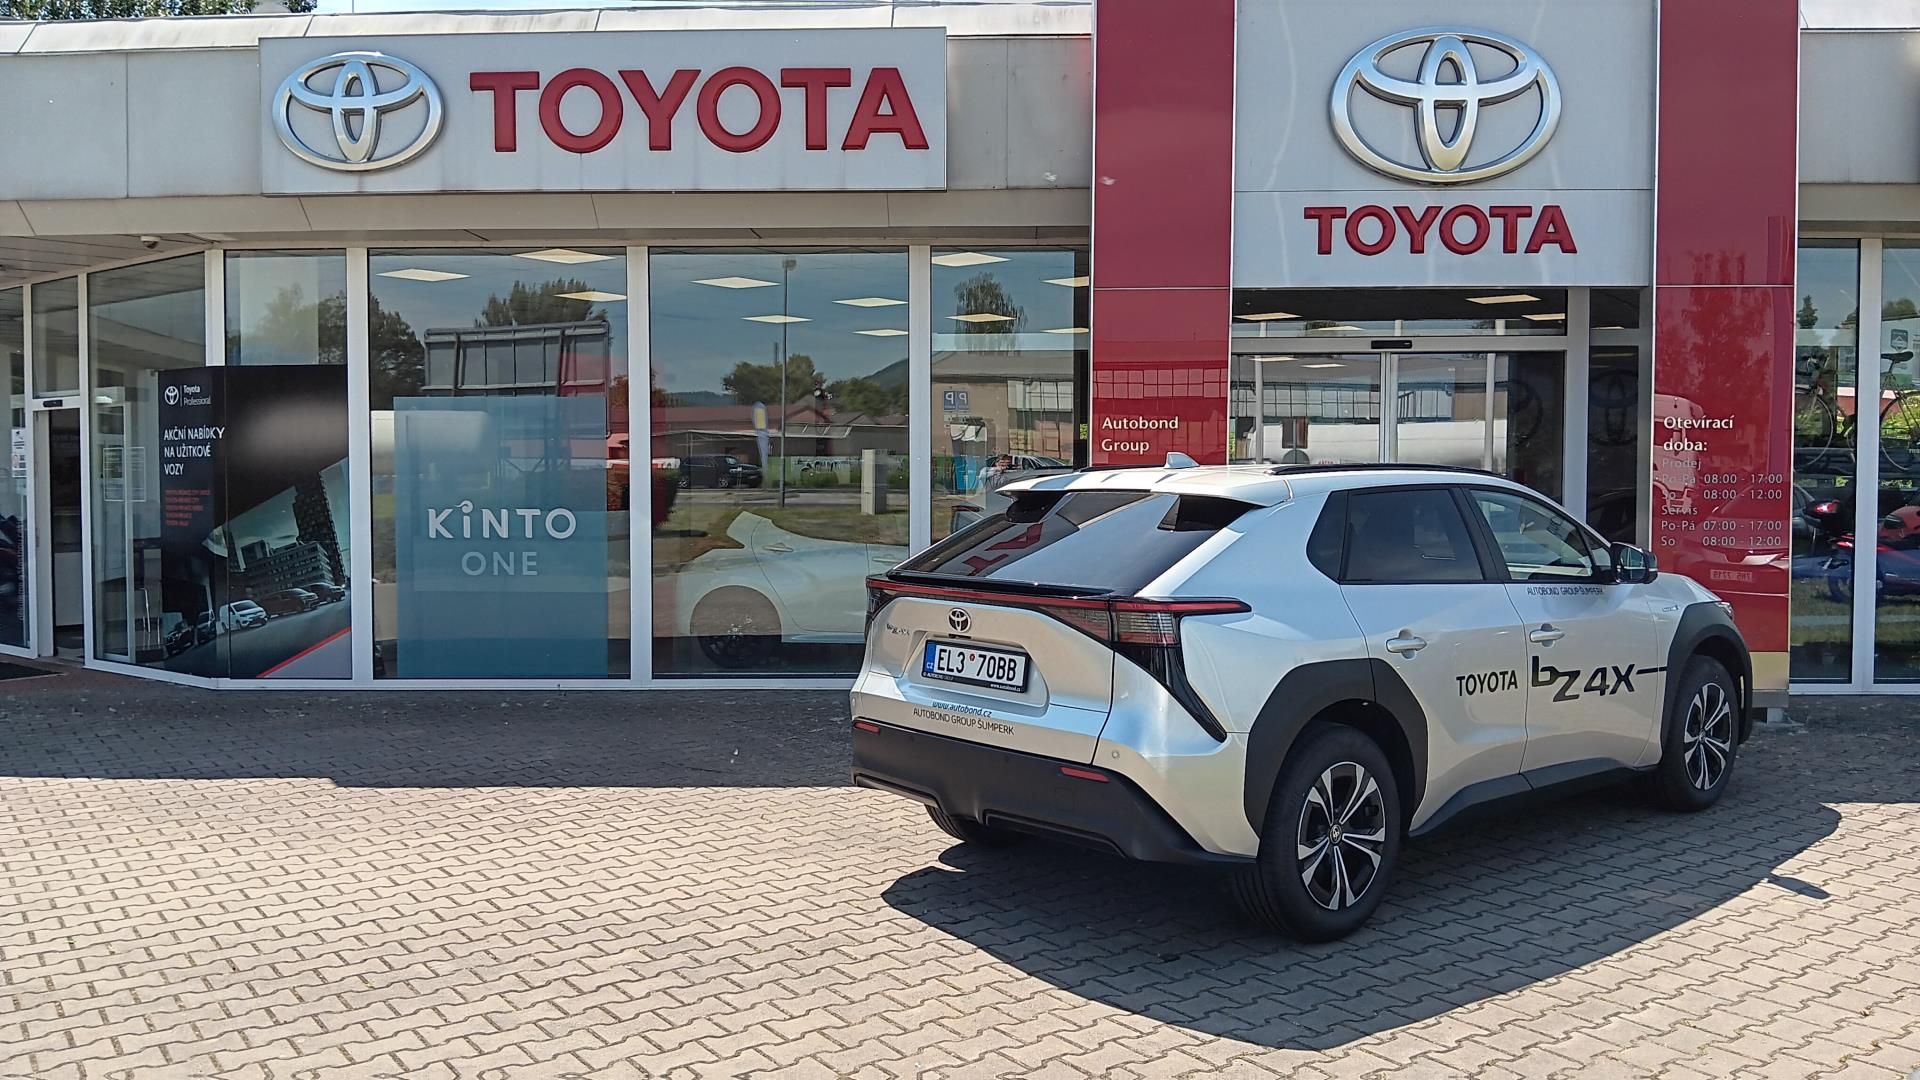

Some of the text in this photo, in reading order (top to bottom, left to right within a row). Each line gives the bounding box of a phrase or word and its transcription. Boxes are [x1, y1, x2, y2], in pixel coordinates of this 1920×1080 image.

[470, 67, 930, 153] TOYOTA
[1303, 203, 1578, 257] TOYOTA
[183, 385, 201, 396] Toyota
[1102, 416, 1180, 429] Autobond
[1663, 414, 1735, 430] Otevírací
[164, 425, 225, 440] AKČNÍ NABÍDKY
[164, 442, 211, 458] NA UŽITKOVÉ
[1101, 438, 1150, 454] Group
[1663, 438, 1708, 452] doba:
[163, 463, 184, 476] VOZY
[1662, 458, 1702, 471] Prodej
[1704, 474, 1737, 484] 08:00
[1751, 474, 1783, 484] 17:00
[1661, 490, 1676, 501] So
[1703, 490, 1737, 500] 08:00
[1750, 489, 1782, 500] 12:00
[1661, 505, 1698, 516] Servis
[1703, 520, 1736, 531] 07:00
[1750, 520, 1782, 531] 17:00
[1661, 536, 1676, 546] So
[1702, 536, 1736, 546] 08:00
[1750, 536, 1782, 546] 12:00
[461, 551, 538, 576] ONE
[1527, 586, 1560, 595] AUTOBOND
[937, 648, 1017, 682] EL3 70BB
[1456, 670, 1518, 696] TOYOTA
[932, 700, 993, 718] www.autobond.cz
[913, 707, 1015, 735] AUTOBOND GROUP ŠUMPERK
